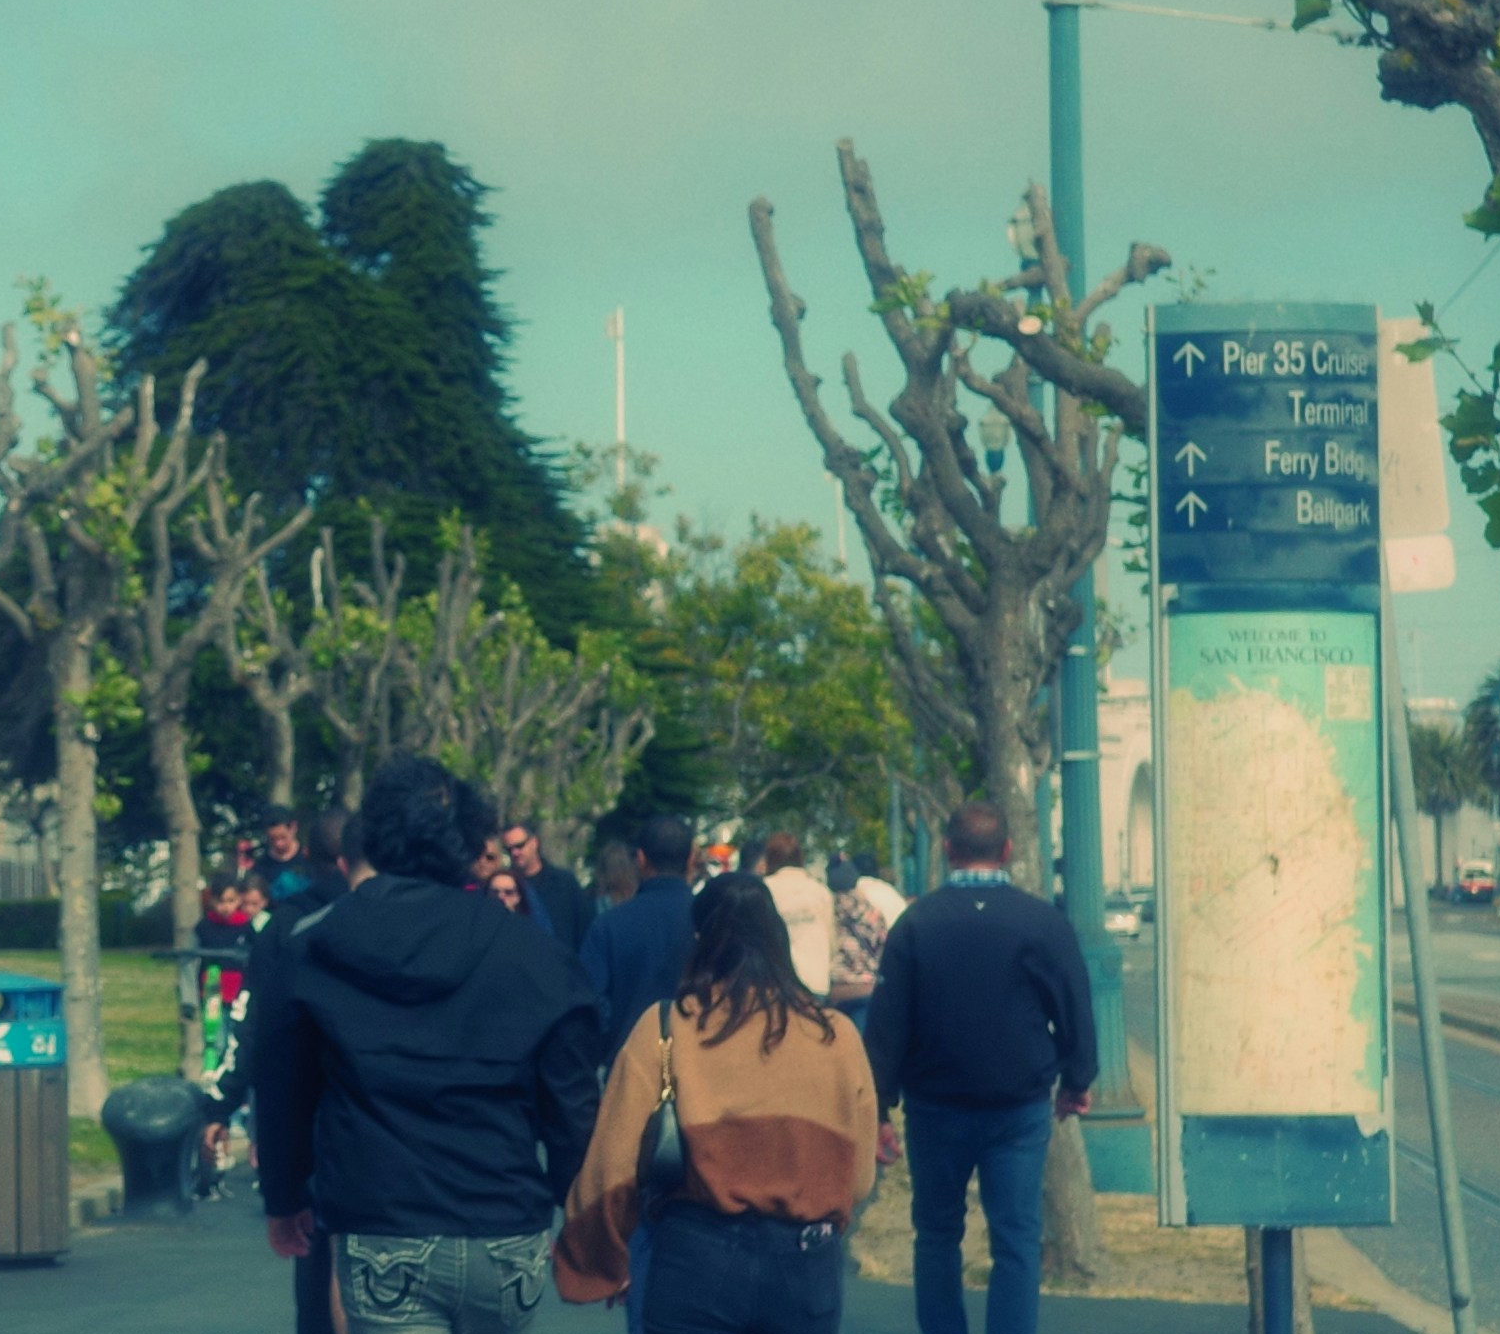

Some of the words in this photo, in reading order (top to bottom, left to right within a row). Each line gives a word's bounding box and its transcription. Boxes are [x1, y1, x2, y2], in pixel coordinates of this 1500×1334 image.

[1222, 340, 1267, 376] Pier
[1272, 340, 1305, 376] 35
[1311, 340, 1368, 376] Cruise
[1288, 389, 1369, 426] Terminal
[1264, 440, 1319, 480] Ferry
[1296, 490, 1371, 530] Ballpark
[1228, 629, 1300, 643] WELCOME
[1199, 646, 1239, 665] SAN
[1245, 645, 1355, 664] FRANCISCO
